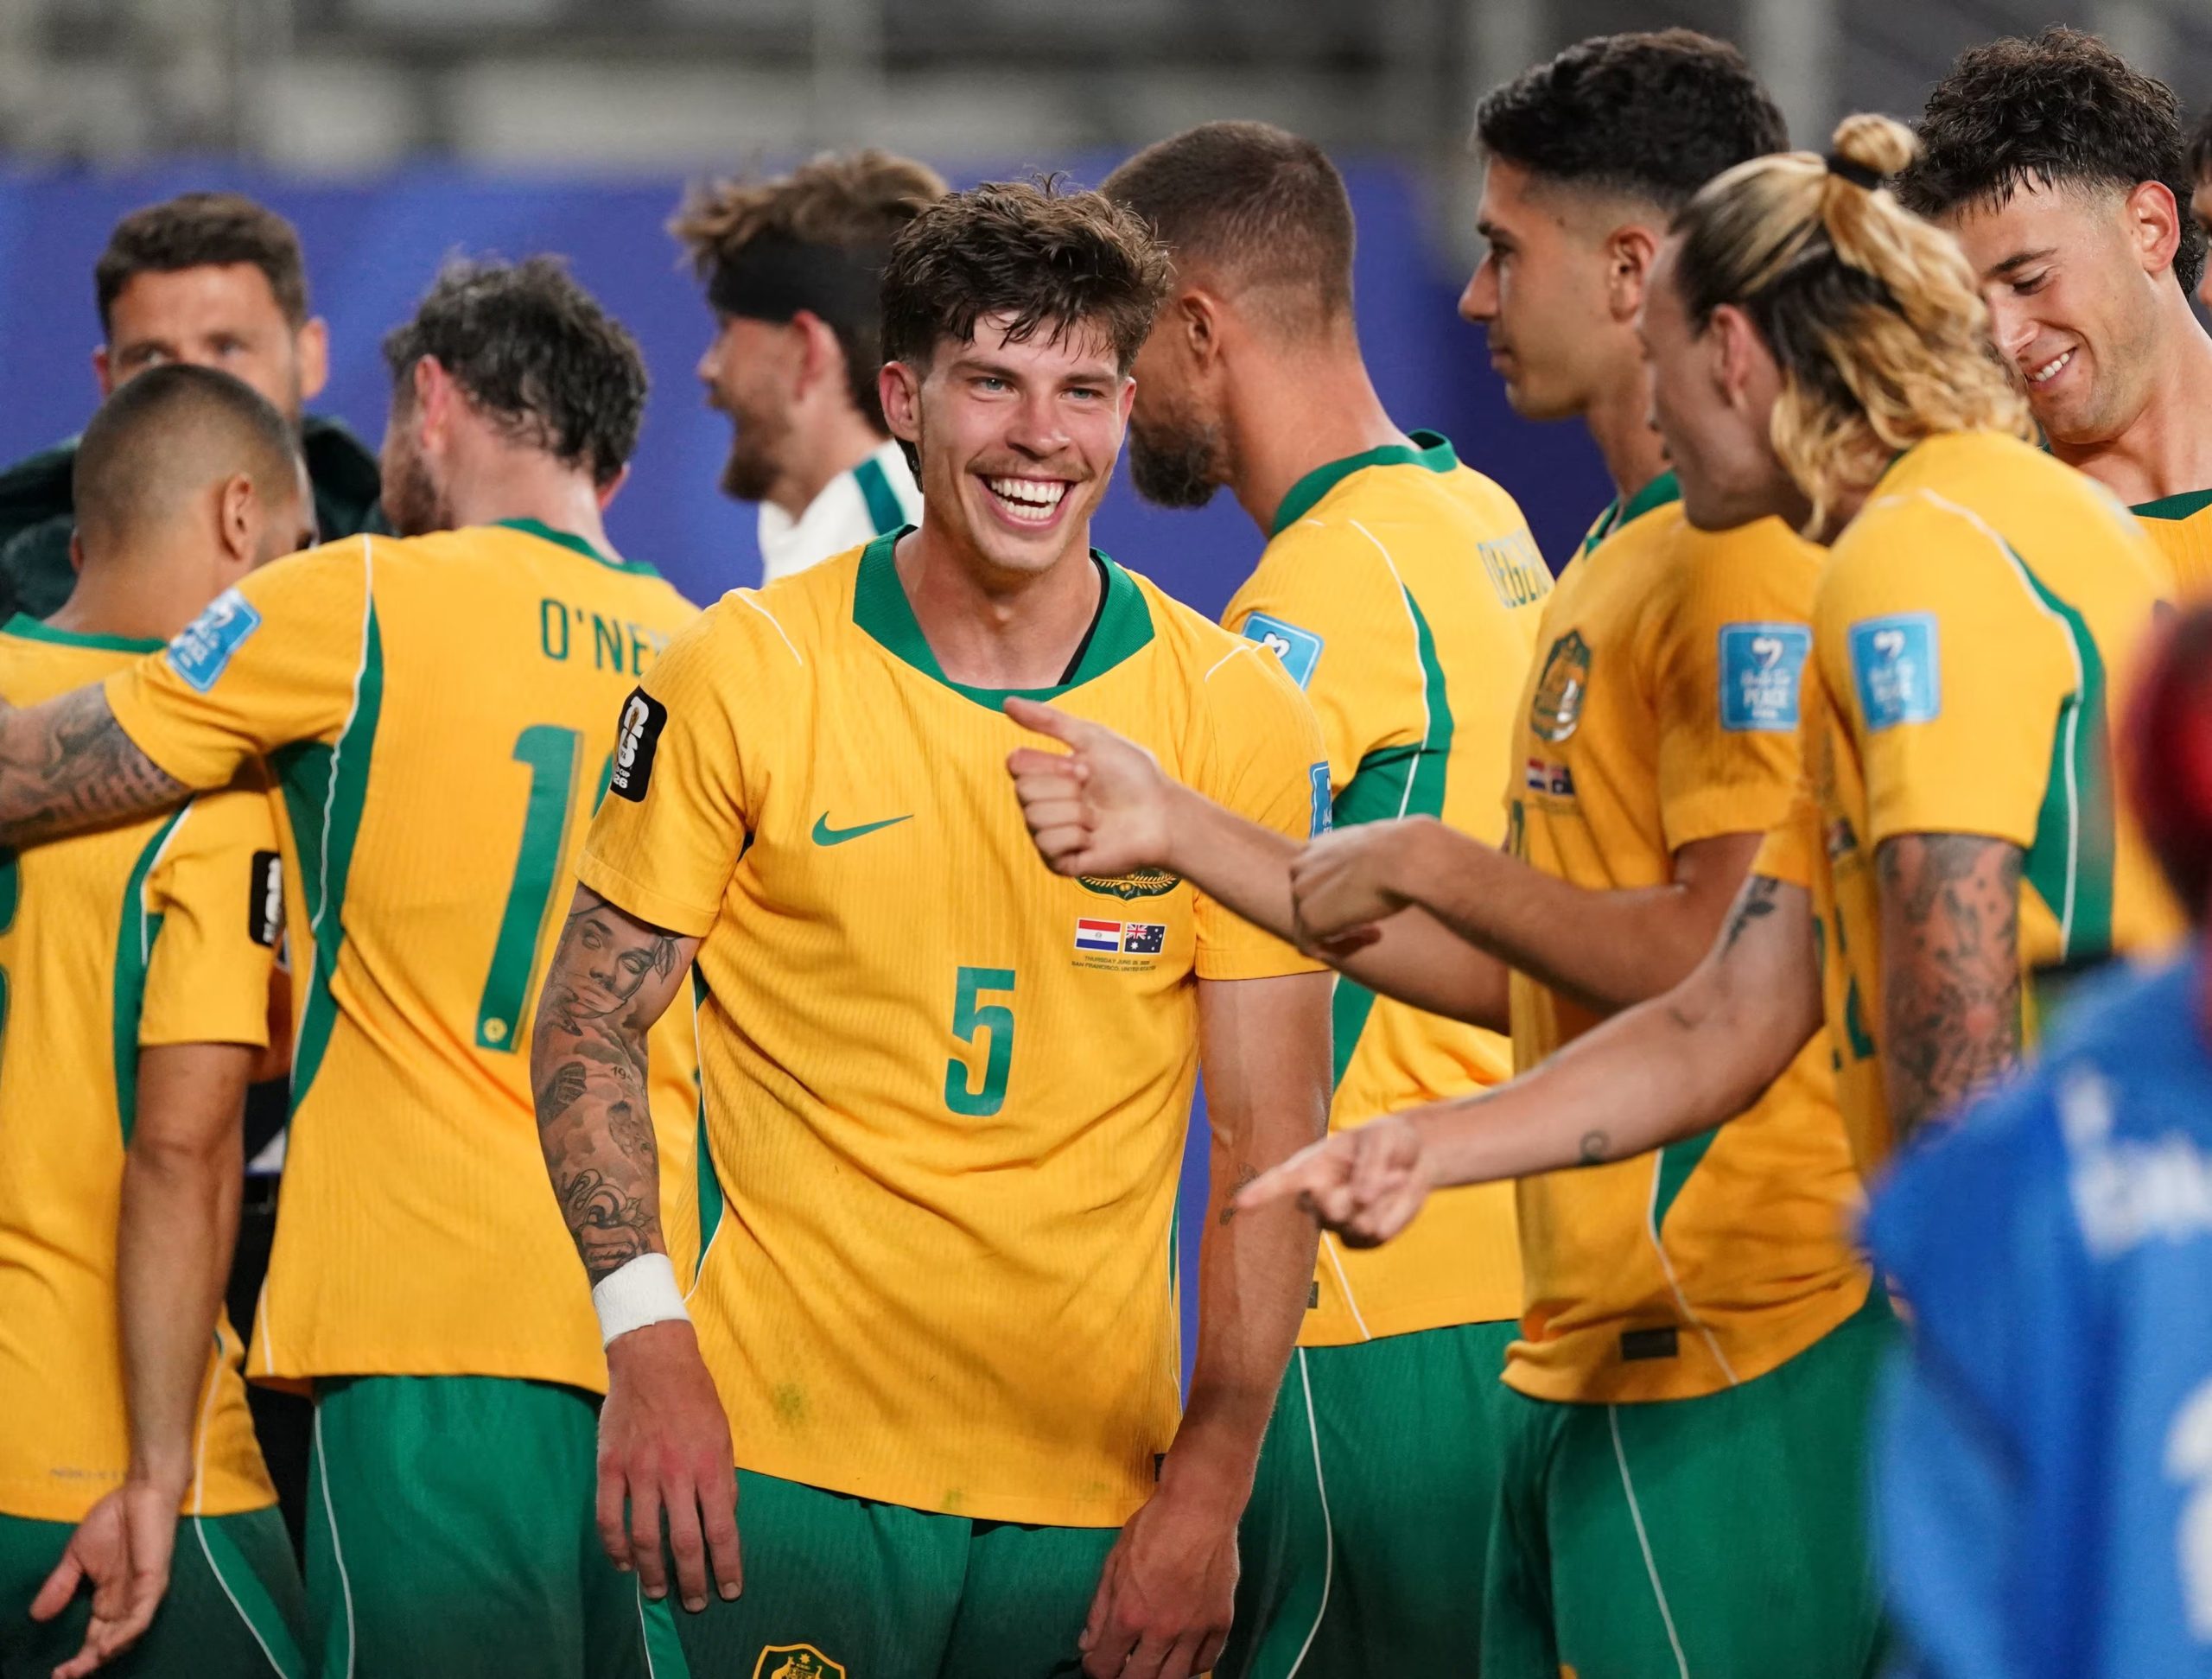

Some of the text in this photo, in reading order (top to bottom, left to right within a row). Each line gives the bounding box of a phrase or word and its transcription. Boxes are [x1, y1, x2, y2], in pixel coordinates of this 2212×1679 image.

[541, 598, 666, 676] O'NE
[476, 724, 613, 1054] 1
[944, 966, 1015, 1116] 5
